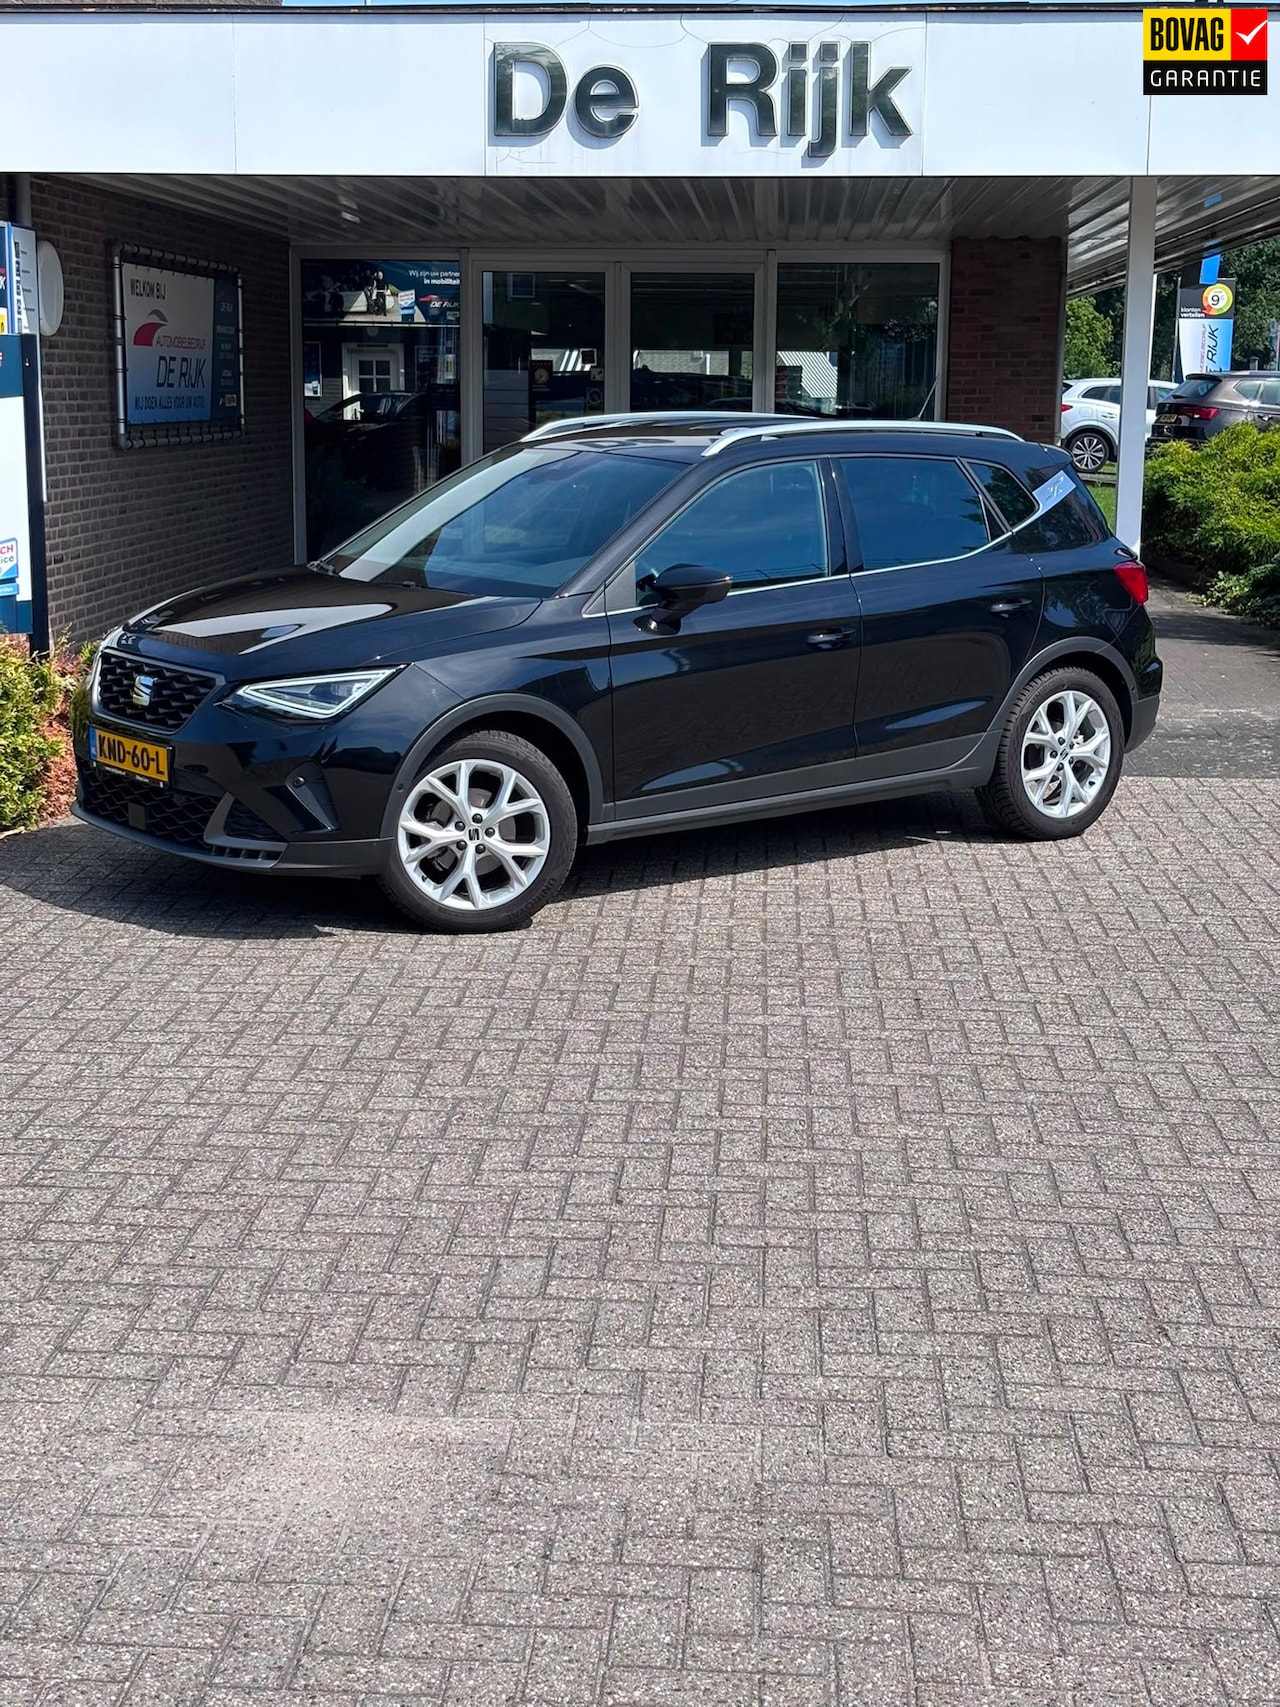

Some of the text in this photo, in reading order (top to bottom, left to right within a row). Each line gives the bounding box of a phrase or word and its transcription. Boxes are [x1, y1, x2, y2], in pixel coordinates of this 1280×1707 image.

[494, 41, 913, 158] De Rijk
[130, 278, 166, 300] WELKOM BIJ
[409, 270, 419, 278] Wij
[1206, 324, 1220, 364] RIJK
[156, 355, 207, 389] DE RIJK
[0, 544, 14, 555] CH
[98, 734, 165, 776] KND-60-L
